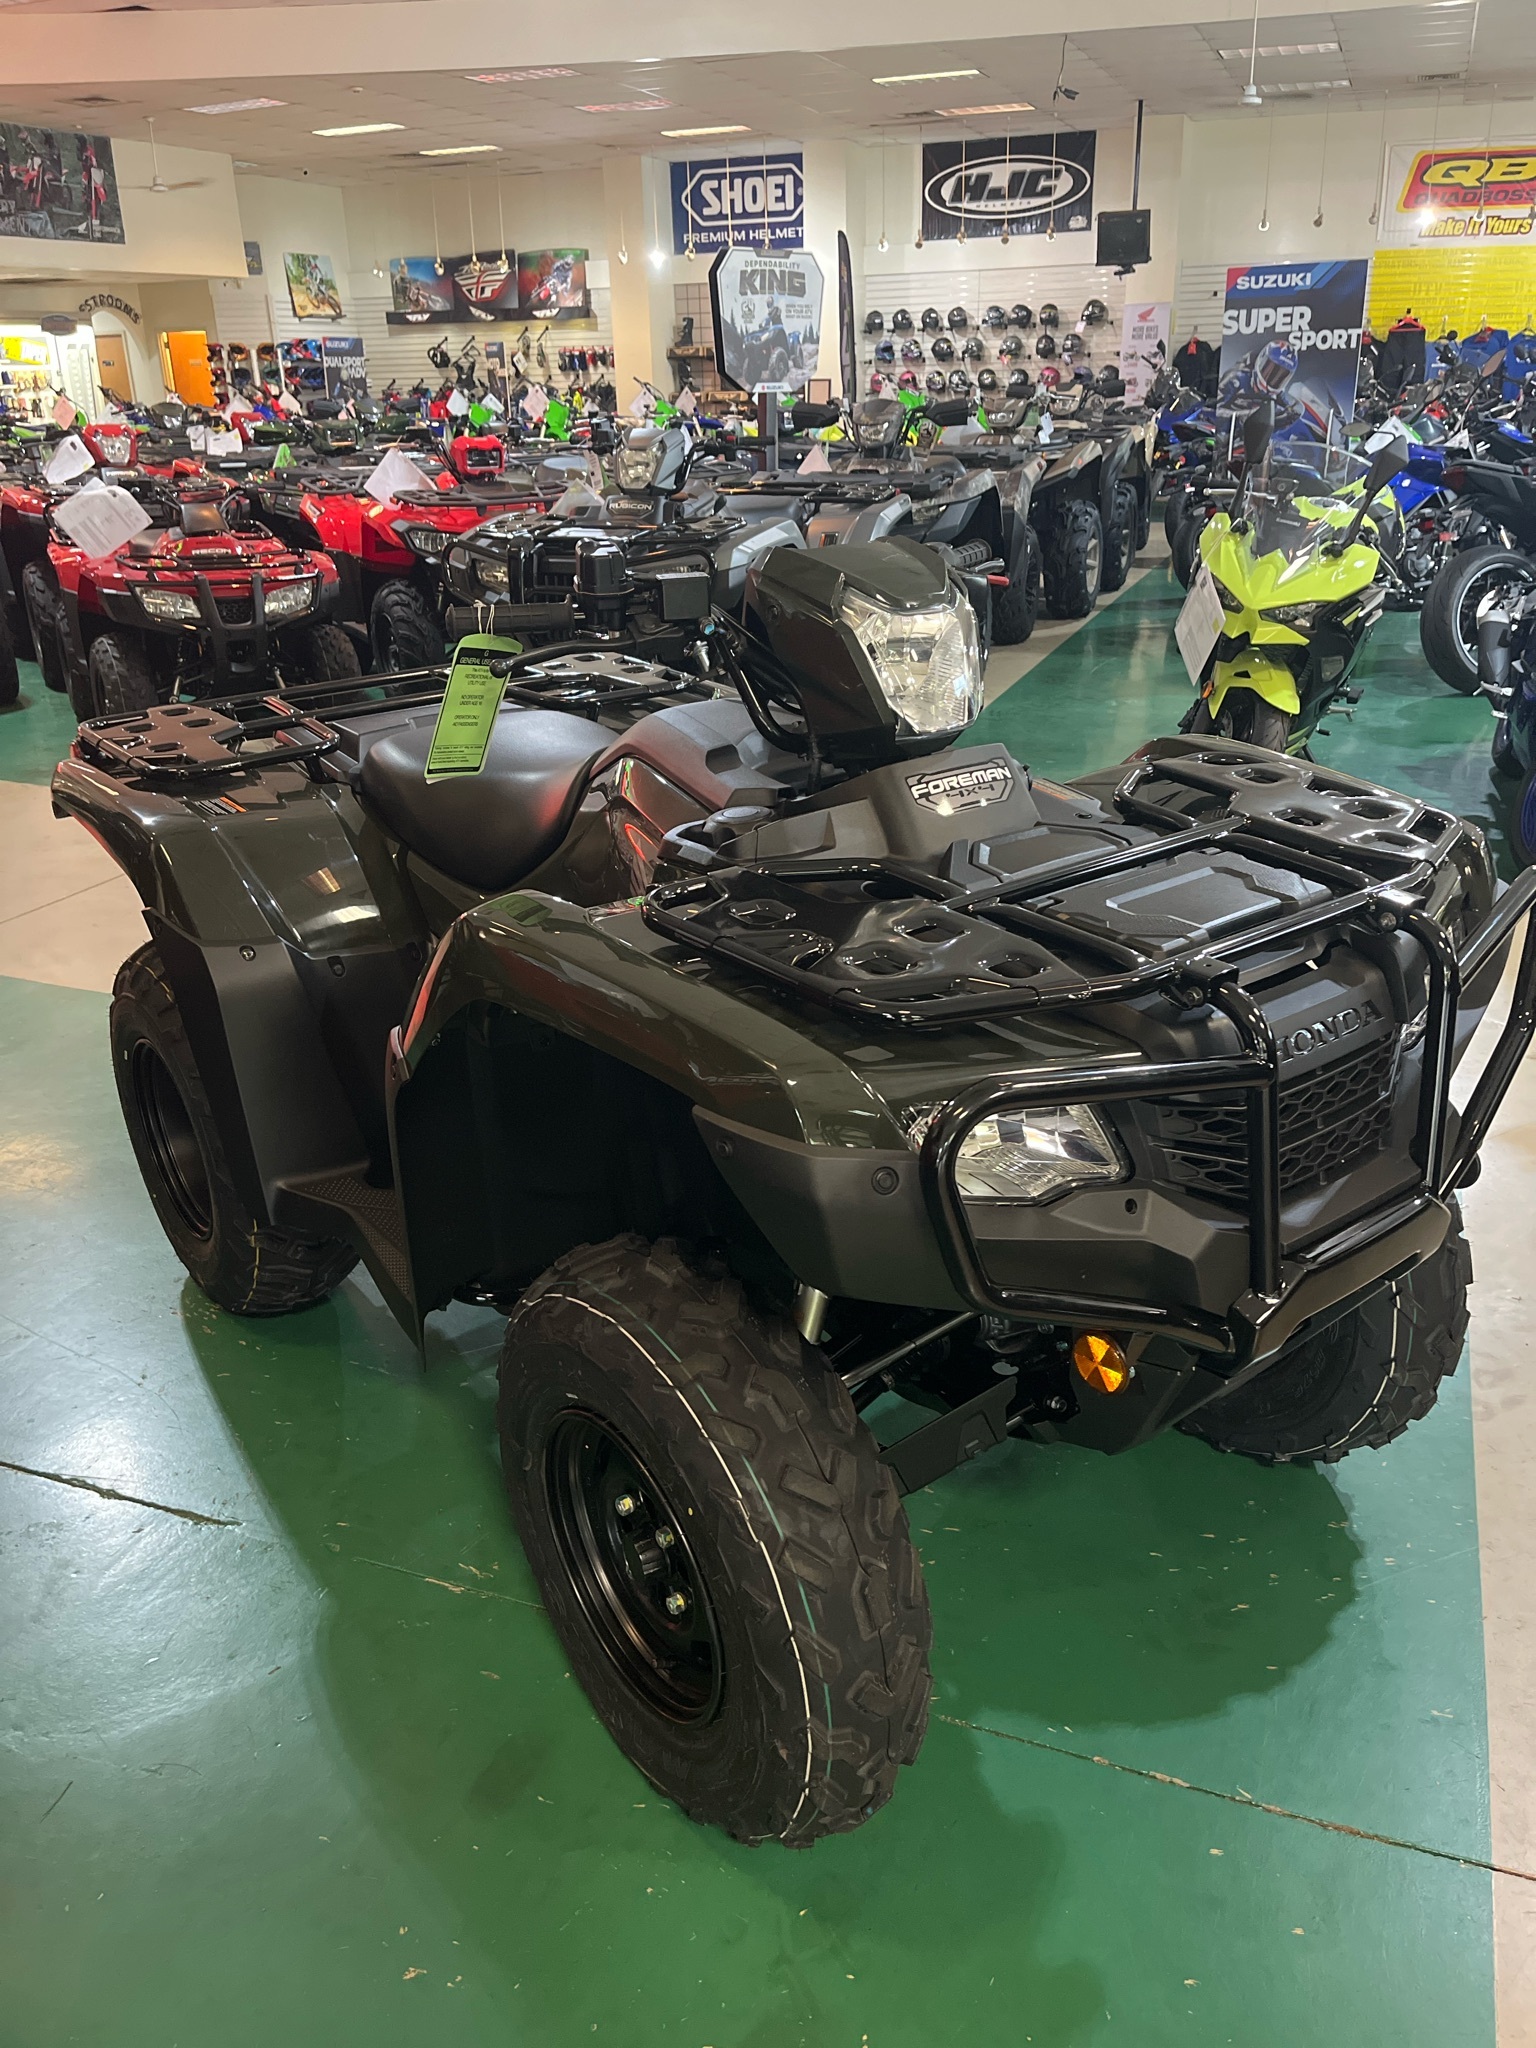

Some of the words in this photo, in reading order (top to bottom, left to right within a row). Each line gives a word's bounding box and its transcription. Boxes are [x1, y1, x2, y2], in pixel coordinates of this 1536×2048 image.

[701, 174, 795, 216] SHOEI
[947, 166, 1063, 204] HJC
[1485, 215, 1534, 236] Yours
[683, 229, 746, 244] PREMIUM
[744, 259, 801, 269] DEPENDABILITY
[739, 268, 807, 298] KING
[1236, 272, 1312, 290] SUZUKI
[1222, 305, 1312, 336] SUPER
[1288, 327, 1363, 351] SPORT
[609, 501, 652, 511] RUBICON
[191, 547, 232, 556] RECON
[460, 656, 480, 665] GENERAL
[910, 766, 1012, 799] FOREMAN
